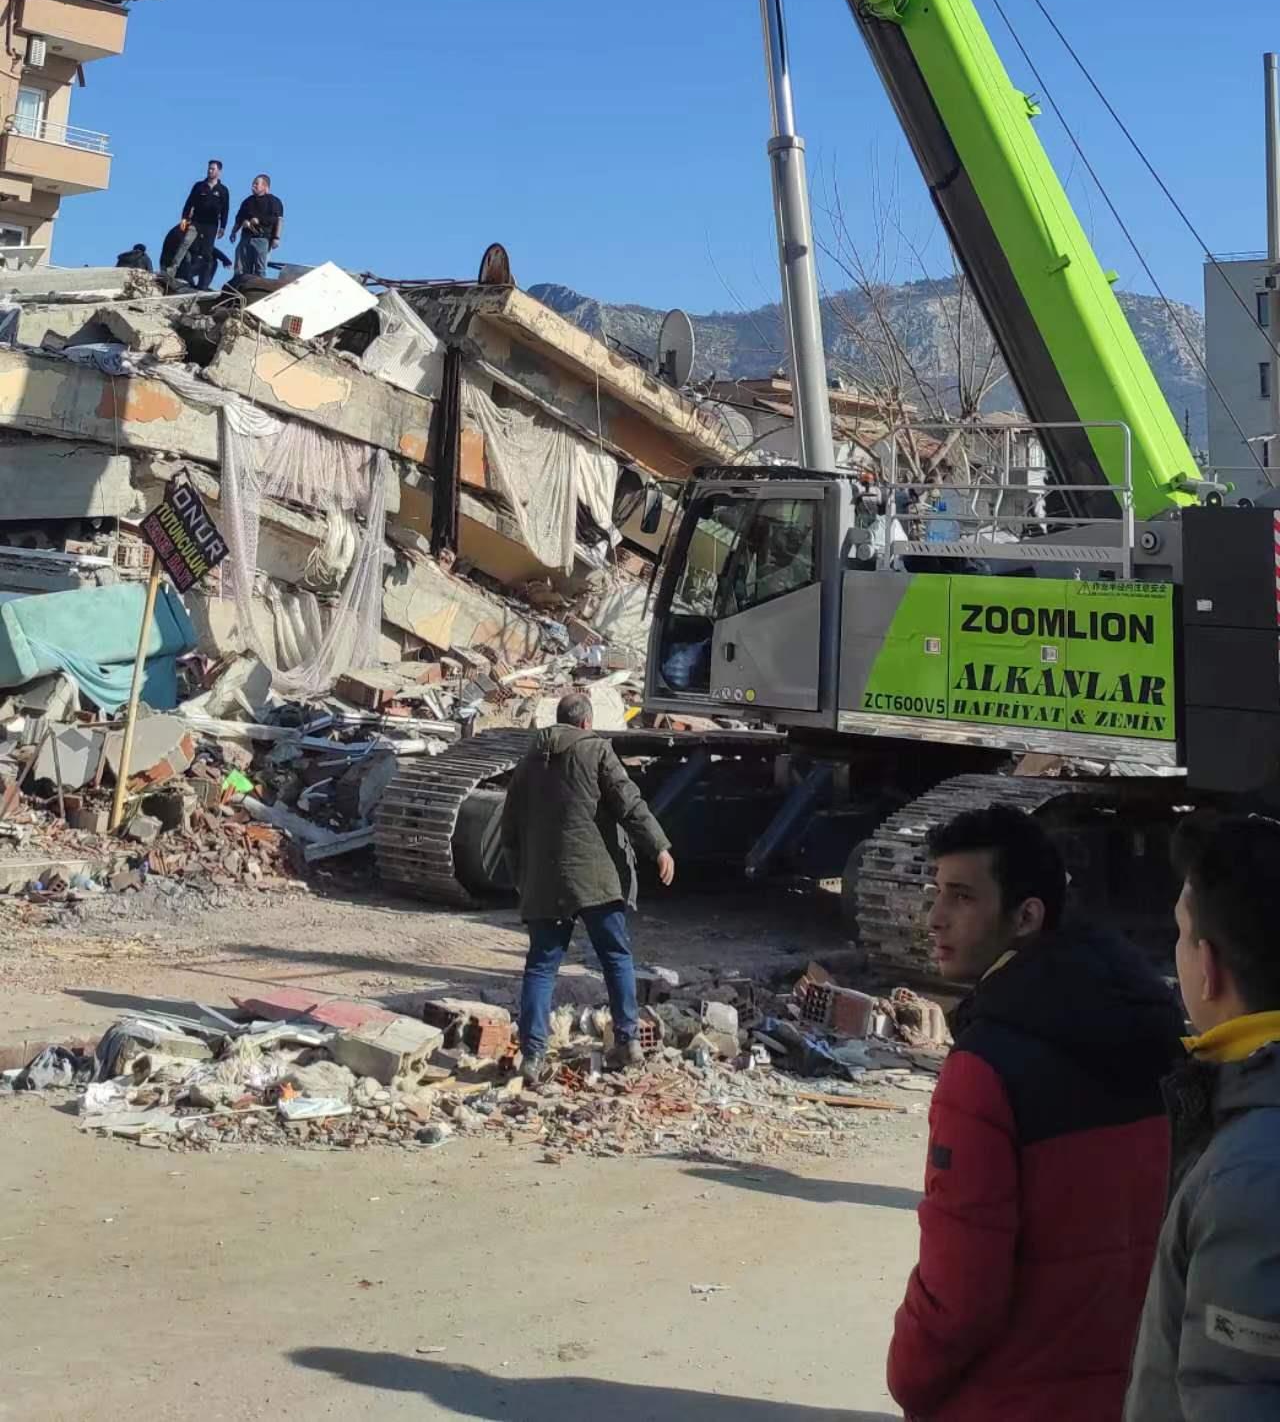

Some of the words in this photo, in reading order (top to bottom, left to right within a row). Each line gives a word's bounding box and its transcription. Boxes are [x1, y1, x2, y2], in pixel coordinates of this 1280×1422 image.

[173, 487, 223, 562] ONUR
[961, 605, 1154, 643] ZOOMLION
[952, 662, 1166, 706] ALKANLAR
[864, 692, 946, 715] ZCT600V5
[952, 698, 1064, 724] HAFRİYAT
[1070, 709, 1087, 726] &
[1094, 712, 1166, 732] ZEMİN
